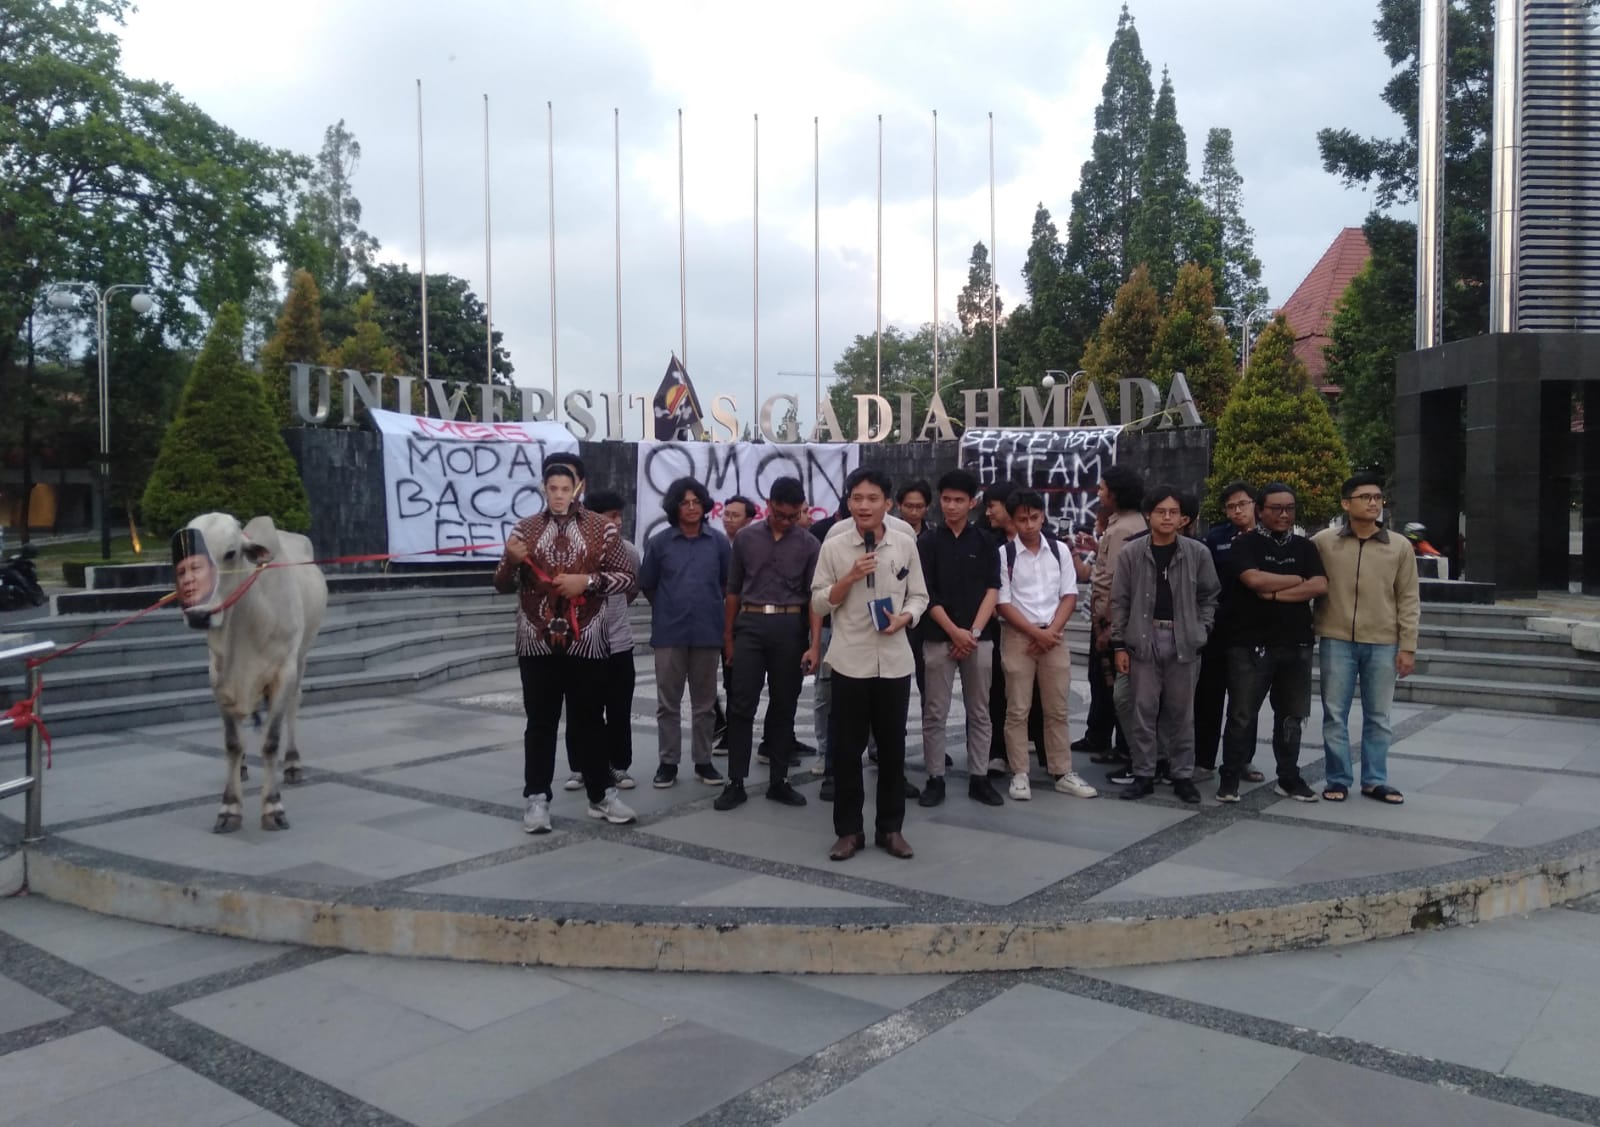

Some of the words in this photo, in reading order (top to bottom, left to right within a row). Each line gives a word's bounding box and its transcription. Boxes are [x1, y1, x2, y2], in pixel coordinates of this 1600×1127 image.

[759, 387, 1004, 444] GADJAH
[1016, 371, 1204, 431] MADA
[979, 453, 1101, 488] HITAM
